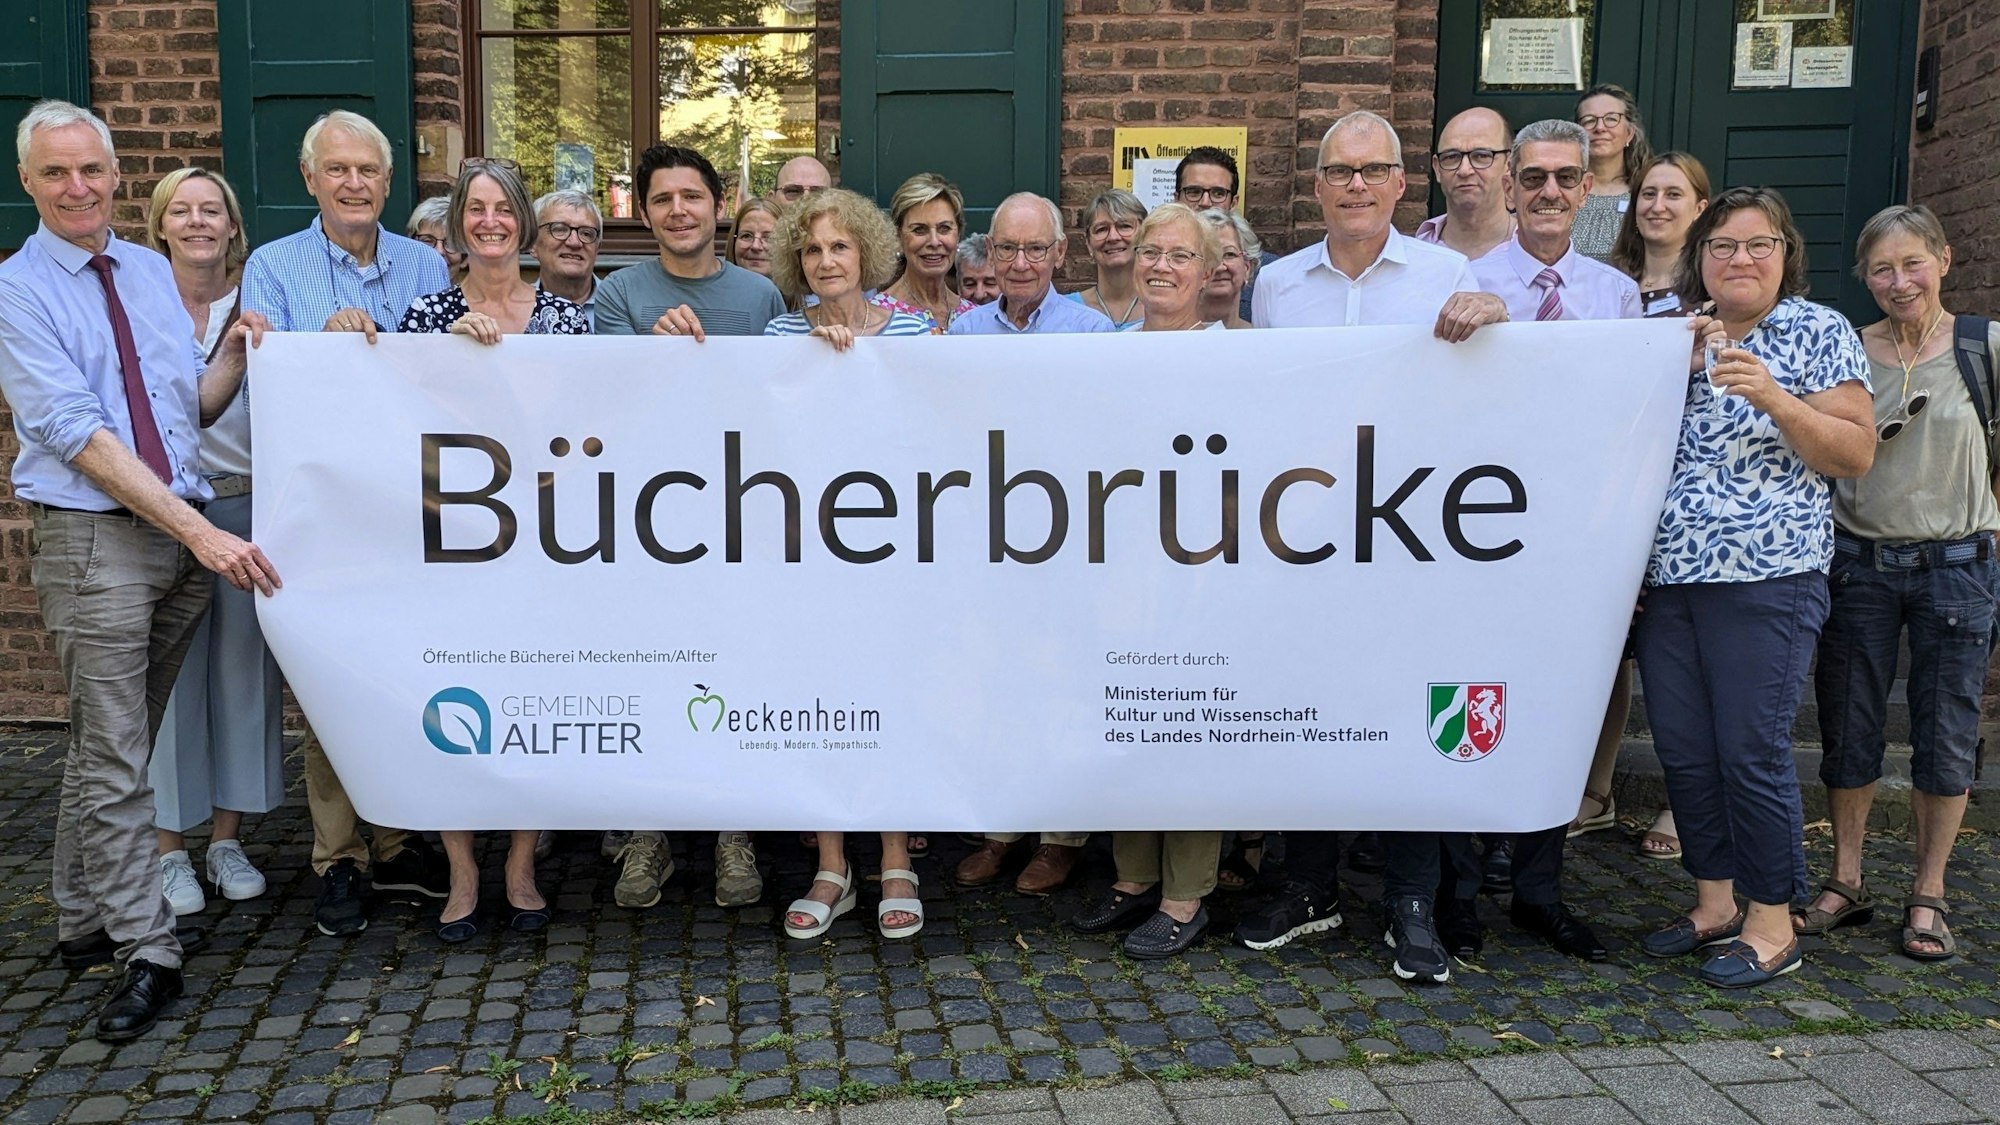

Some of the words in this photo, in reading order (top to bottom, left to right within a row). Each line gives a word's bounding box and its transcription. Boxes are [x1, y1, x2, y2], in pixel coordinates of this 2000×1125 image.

[1156, 144, 1199, 157] Öffentlic
[421, 425, 1527, 565] Bücherbrücke
[423, 648, 506, 663] Öffentliche
[511, 649, 574, 663] Bücherei
[579, 649, 717, 664] Meckenheim/Alfter
[1106, 651, 1178, 666] Gefördert
[1182, 652, 1229, 666] durch:
[1105, 686, 1206, 701] Ministerium
[1212, 687, 1238, 701] für
[501, 695, 640, 717] GEMEINDE
[687, 695, 880, 732] Meckenheim
[1105, 707, 1157, 722] Kultur
[1163, 708, 1195, 722] und
[1201, 707, 1318, 722] Wissenschaft
[500, 723, 643, 754] ALFTER
[1105, 728, 1134, 743] des
[1141, 729, 1202, 743] Landes
[1208, 728, 1388, 743] Nordrhein-Westfalen
[739, 739, 781, 751] Lebendig.
[784, 739, 819, 750] Modern.
[822, 739, 881, 751] Sympathisch.
